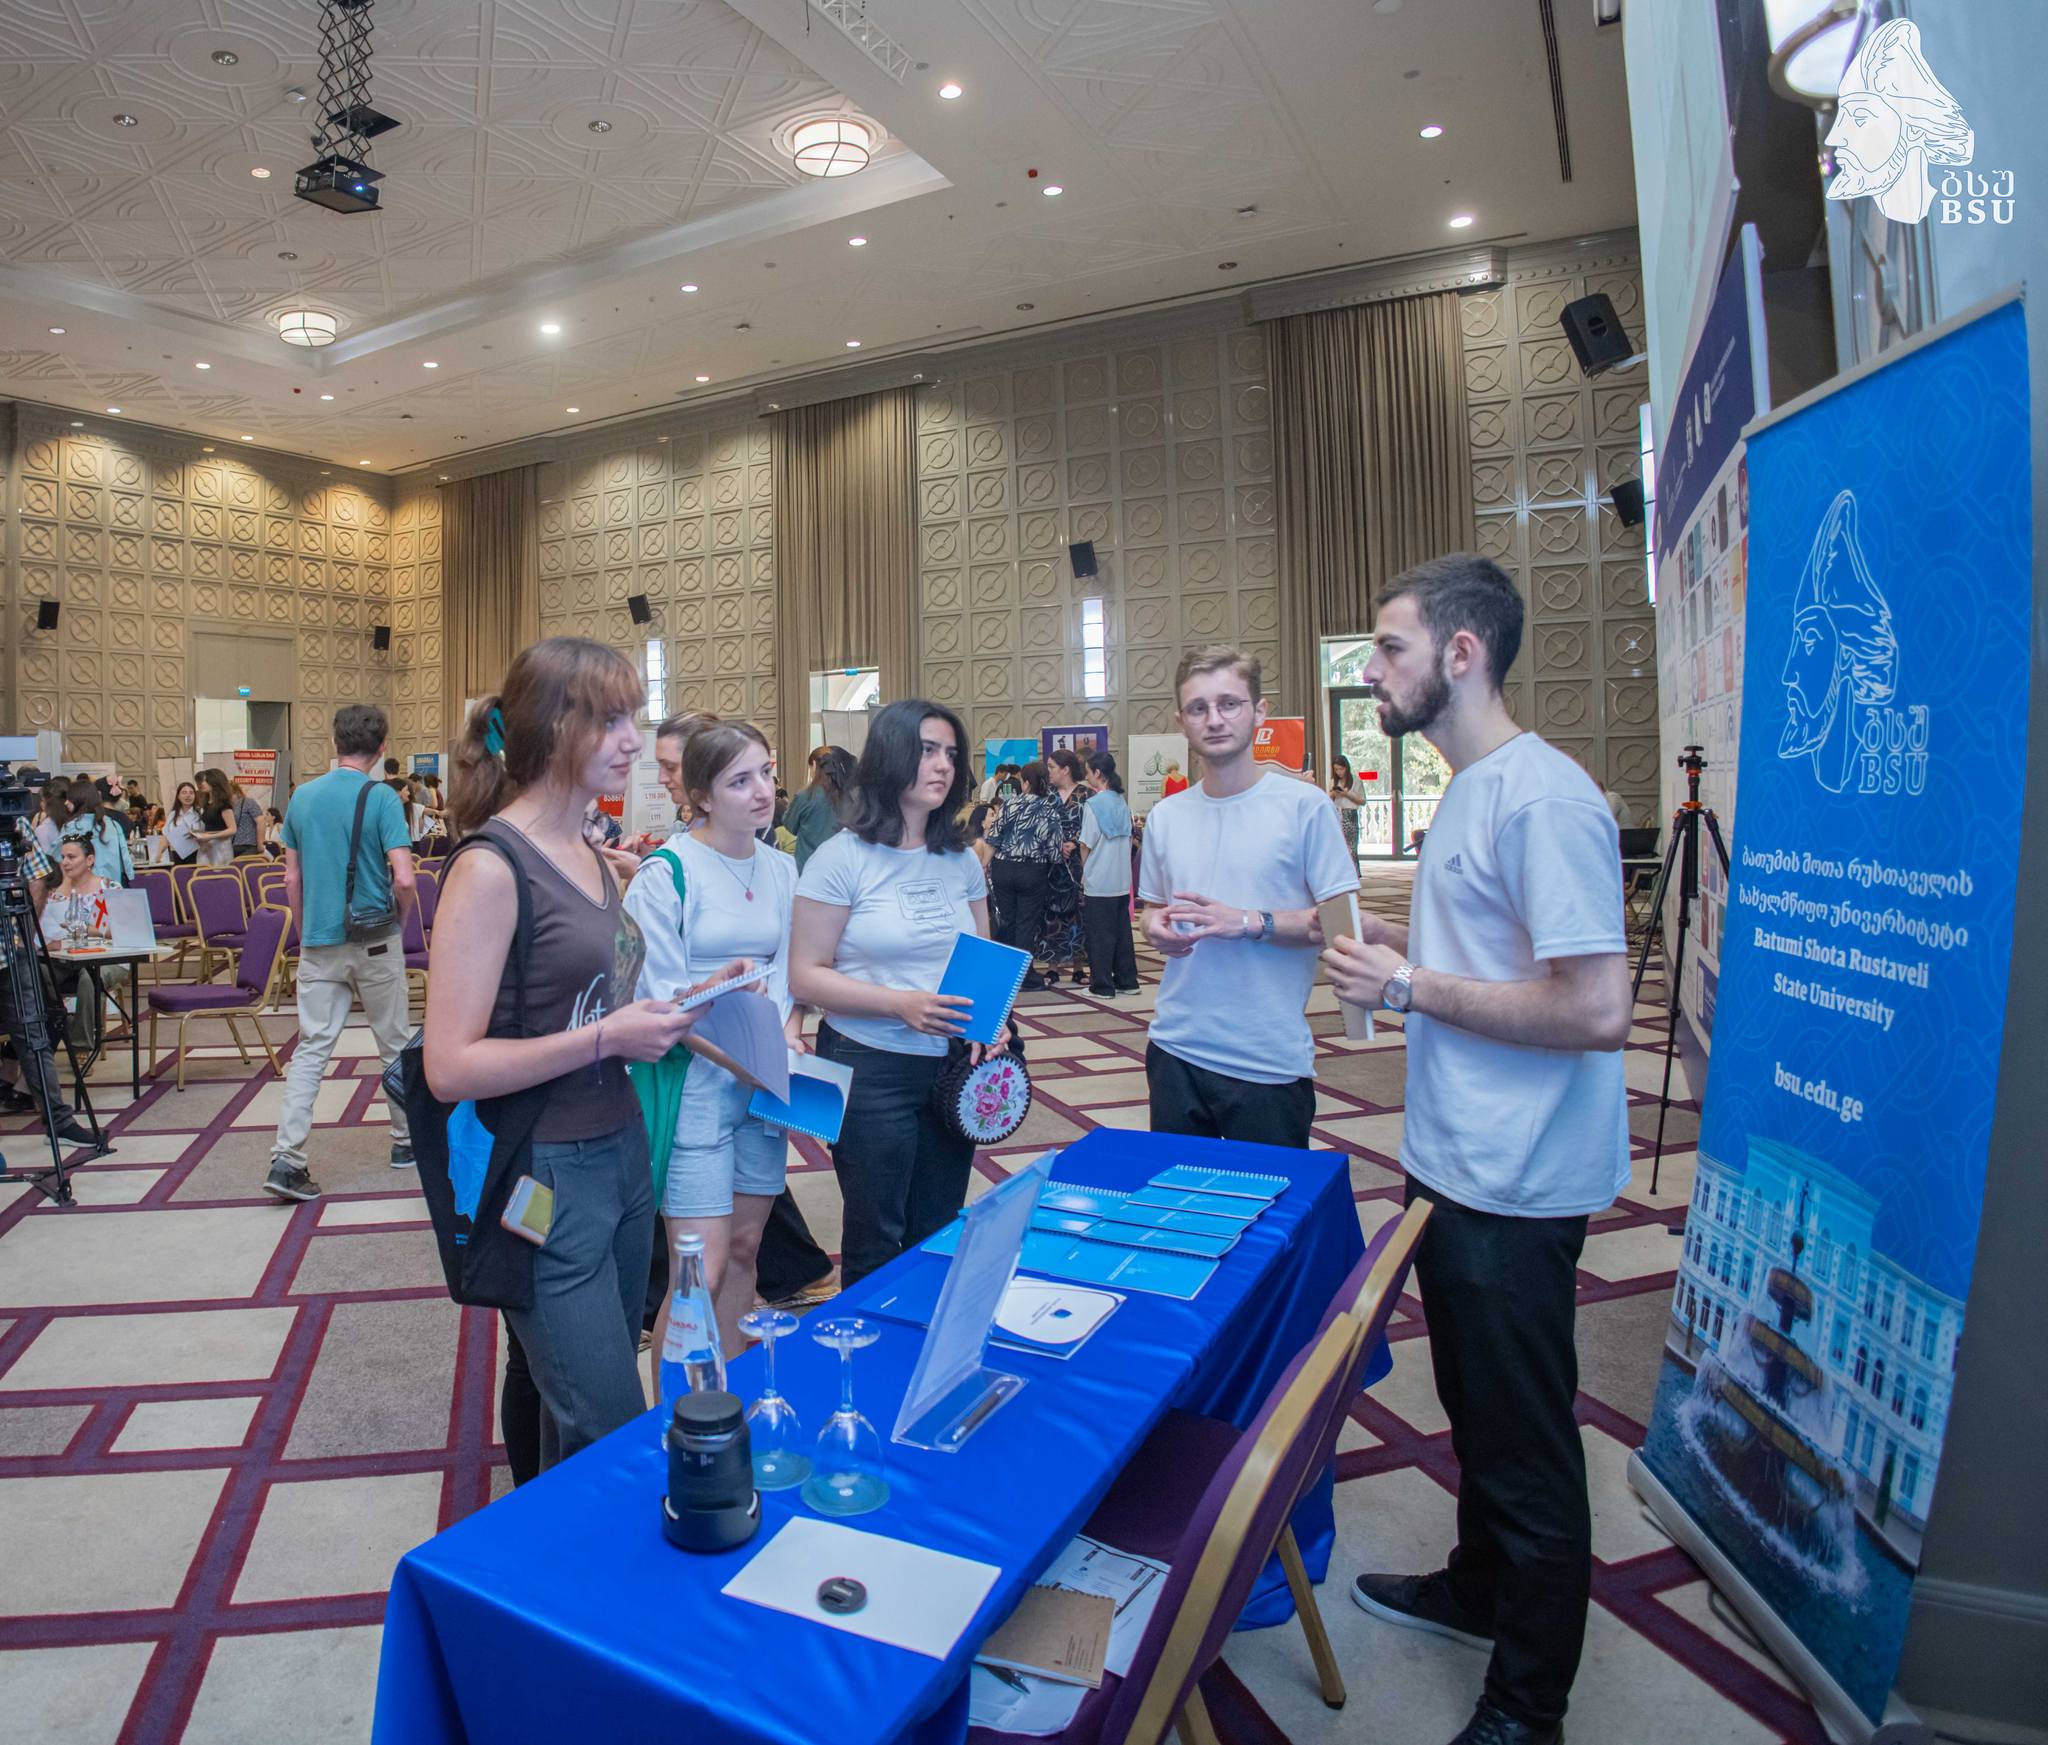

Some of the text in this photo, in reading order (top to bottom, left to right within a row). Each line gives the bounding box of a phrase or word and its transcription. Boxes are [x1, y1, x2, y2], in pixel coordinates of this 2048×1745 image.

[1863, 705, 1929, 752] ბსუ
[1858, 752, 1928, 795] BSU
[1743, 845, 1973, 899] ბათუმის შოთა რუსთაველის
[1739, 883, 1968, 950] სახელმწიფო უნივერსიტეტი
[1753, 927, 1929, 989] Batumi Shota Rustaveli
[1773, 972, 1895, 1032] State University
[1774, 1061, 1864, 1123] bsu.edu.ge
